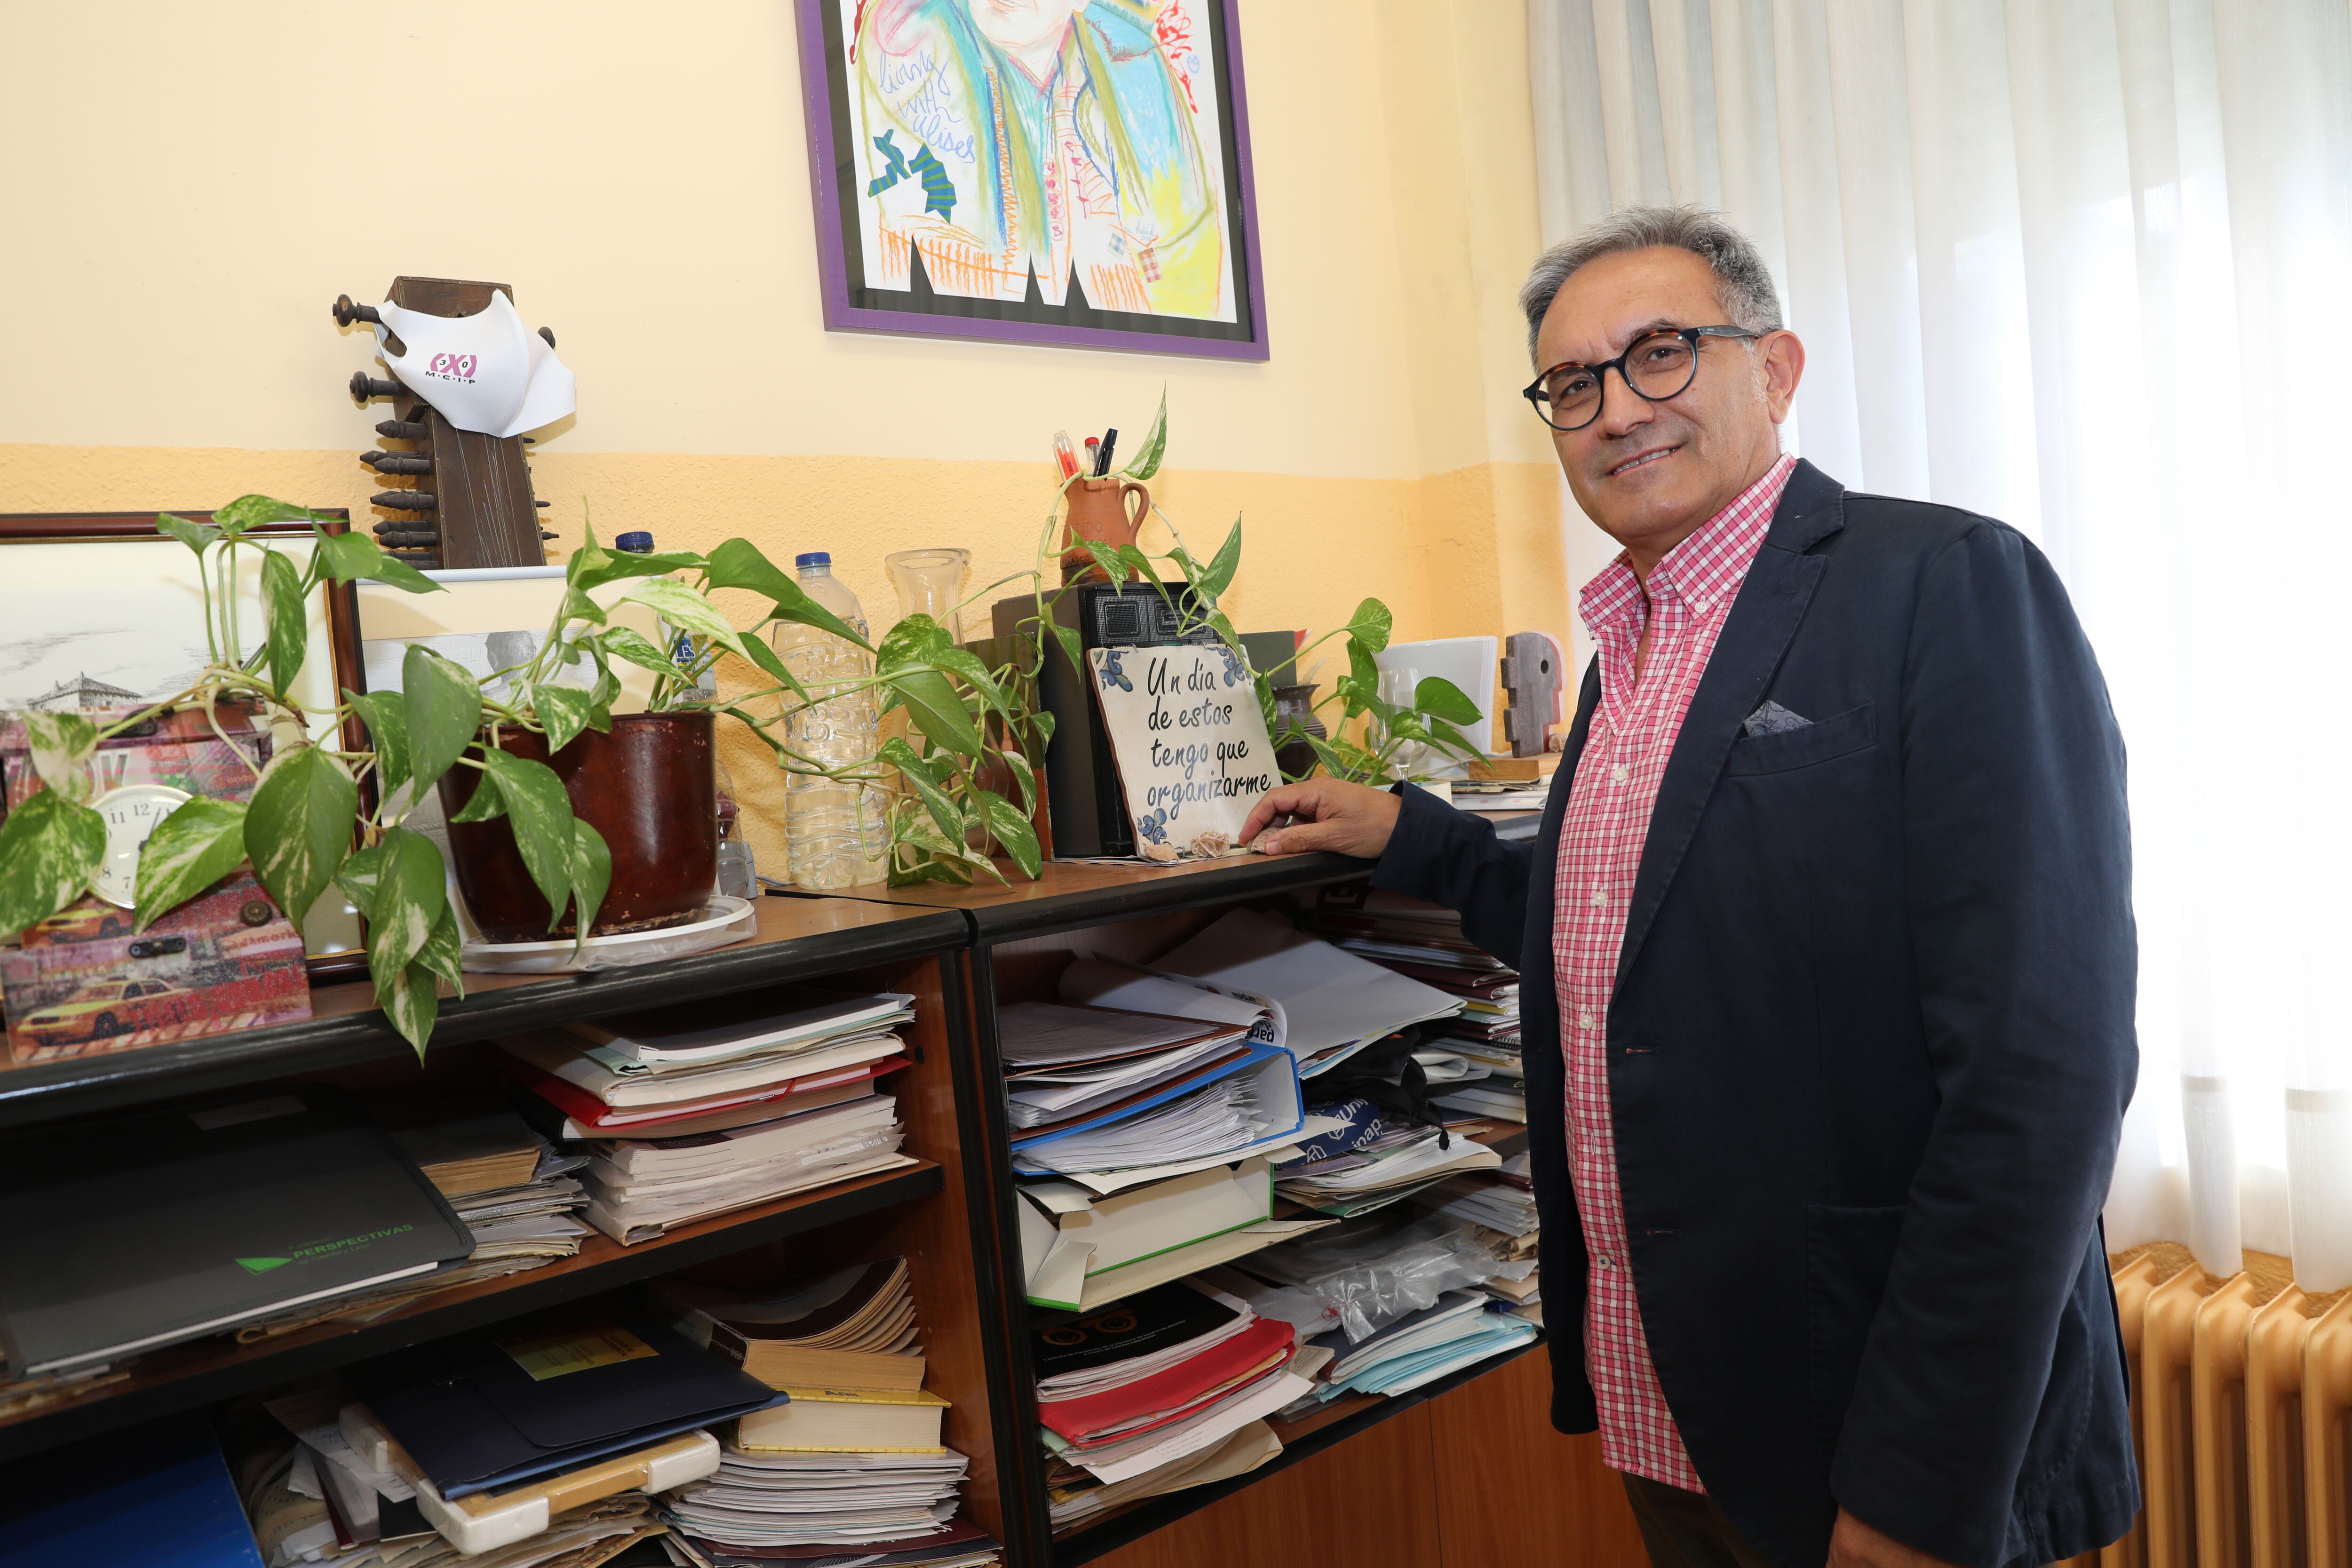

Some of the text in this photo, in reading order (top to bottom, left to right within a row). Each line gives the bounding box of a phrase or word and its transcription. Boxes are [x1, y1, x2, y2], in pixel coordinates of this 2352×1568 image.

[1148, 657, 1216, 696] Un día
[1148, 695, 1232, 730] de estos
[1151, 738, 1248, 780] tengo que
[134, 804, 150, 816] 12
[1147, 770, 1271, 820] organizarme
[111, 812, 125, 824] 11
[103, 868, 111, 879] 8
[123, 876, 130, 888] 7
[294, 1224, 413, 1259] PERSPECTIVAS
